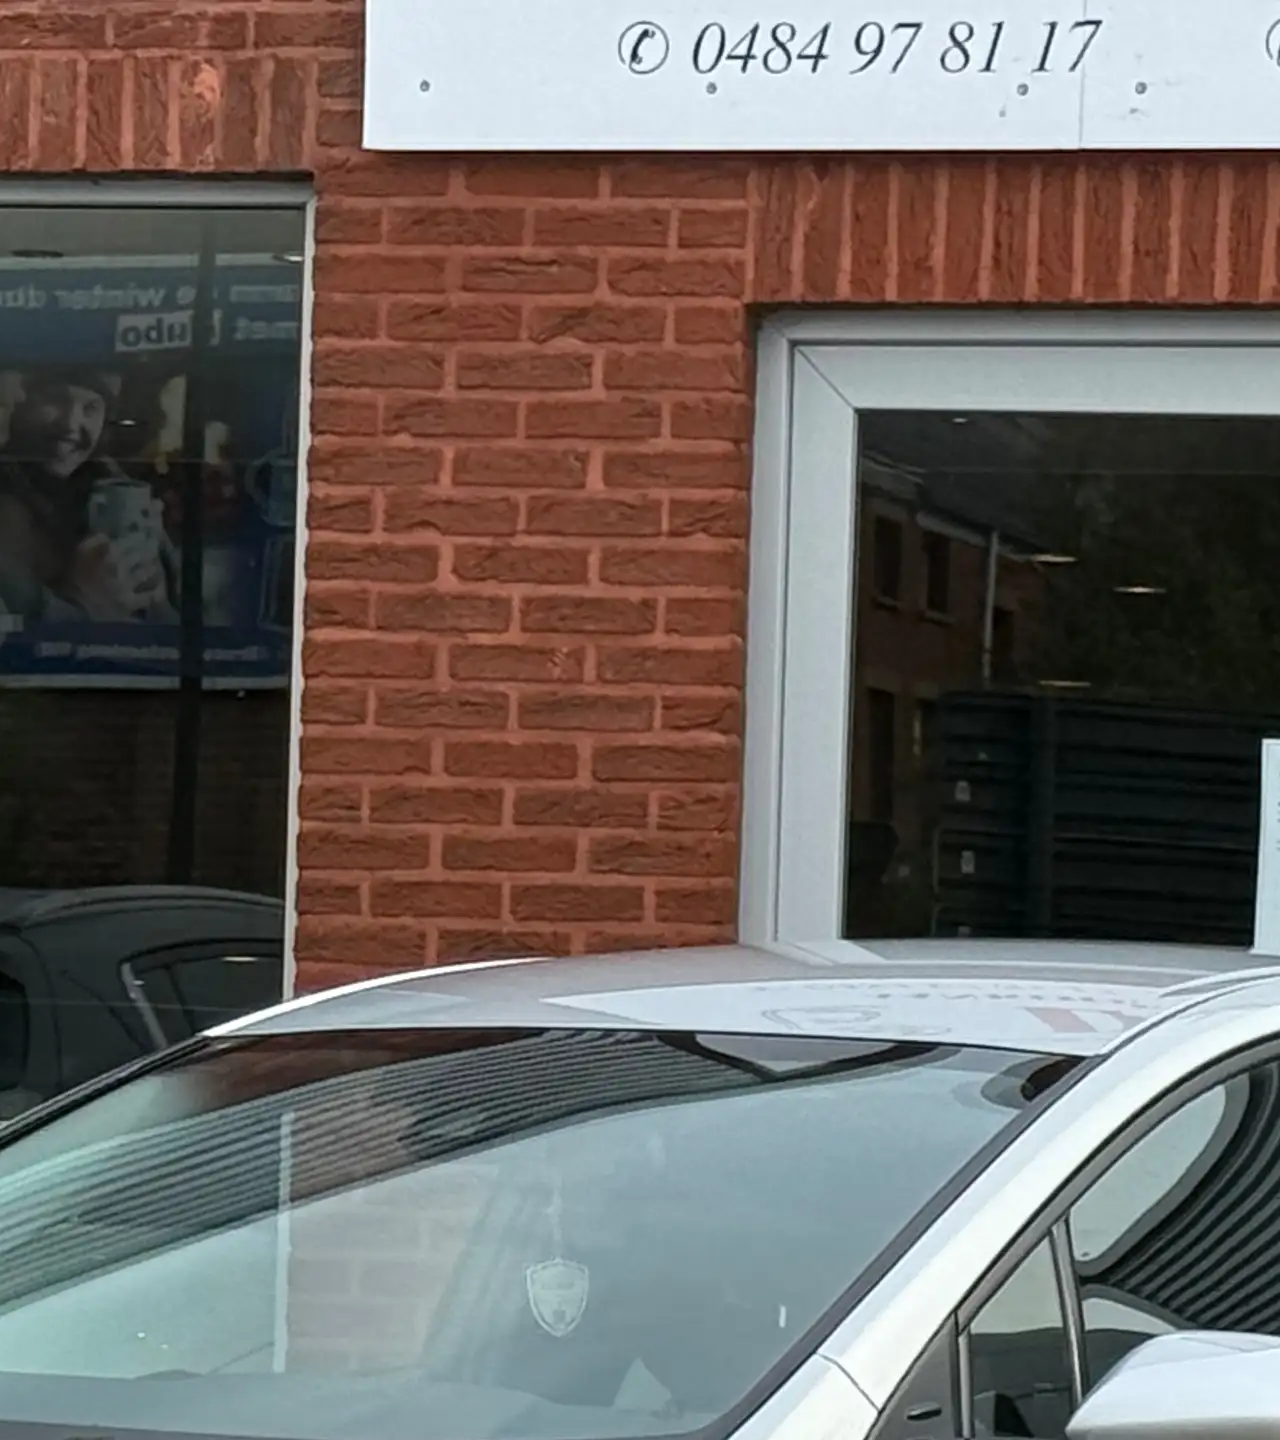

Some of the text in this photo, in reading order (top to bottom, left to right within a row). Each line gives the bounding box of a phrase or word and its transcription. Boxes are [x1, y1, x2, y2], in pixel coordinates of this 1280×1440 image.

[691, 20, 1103, 74] 0484 97 81 17
